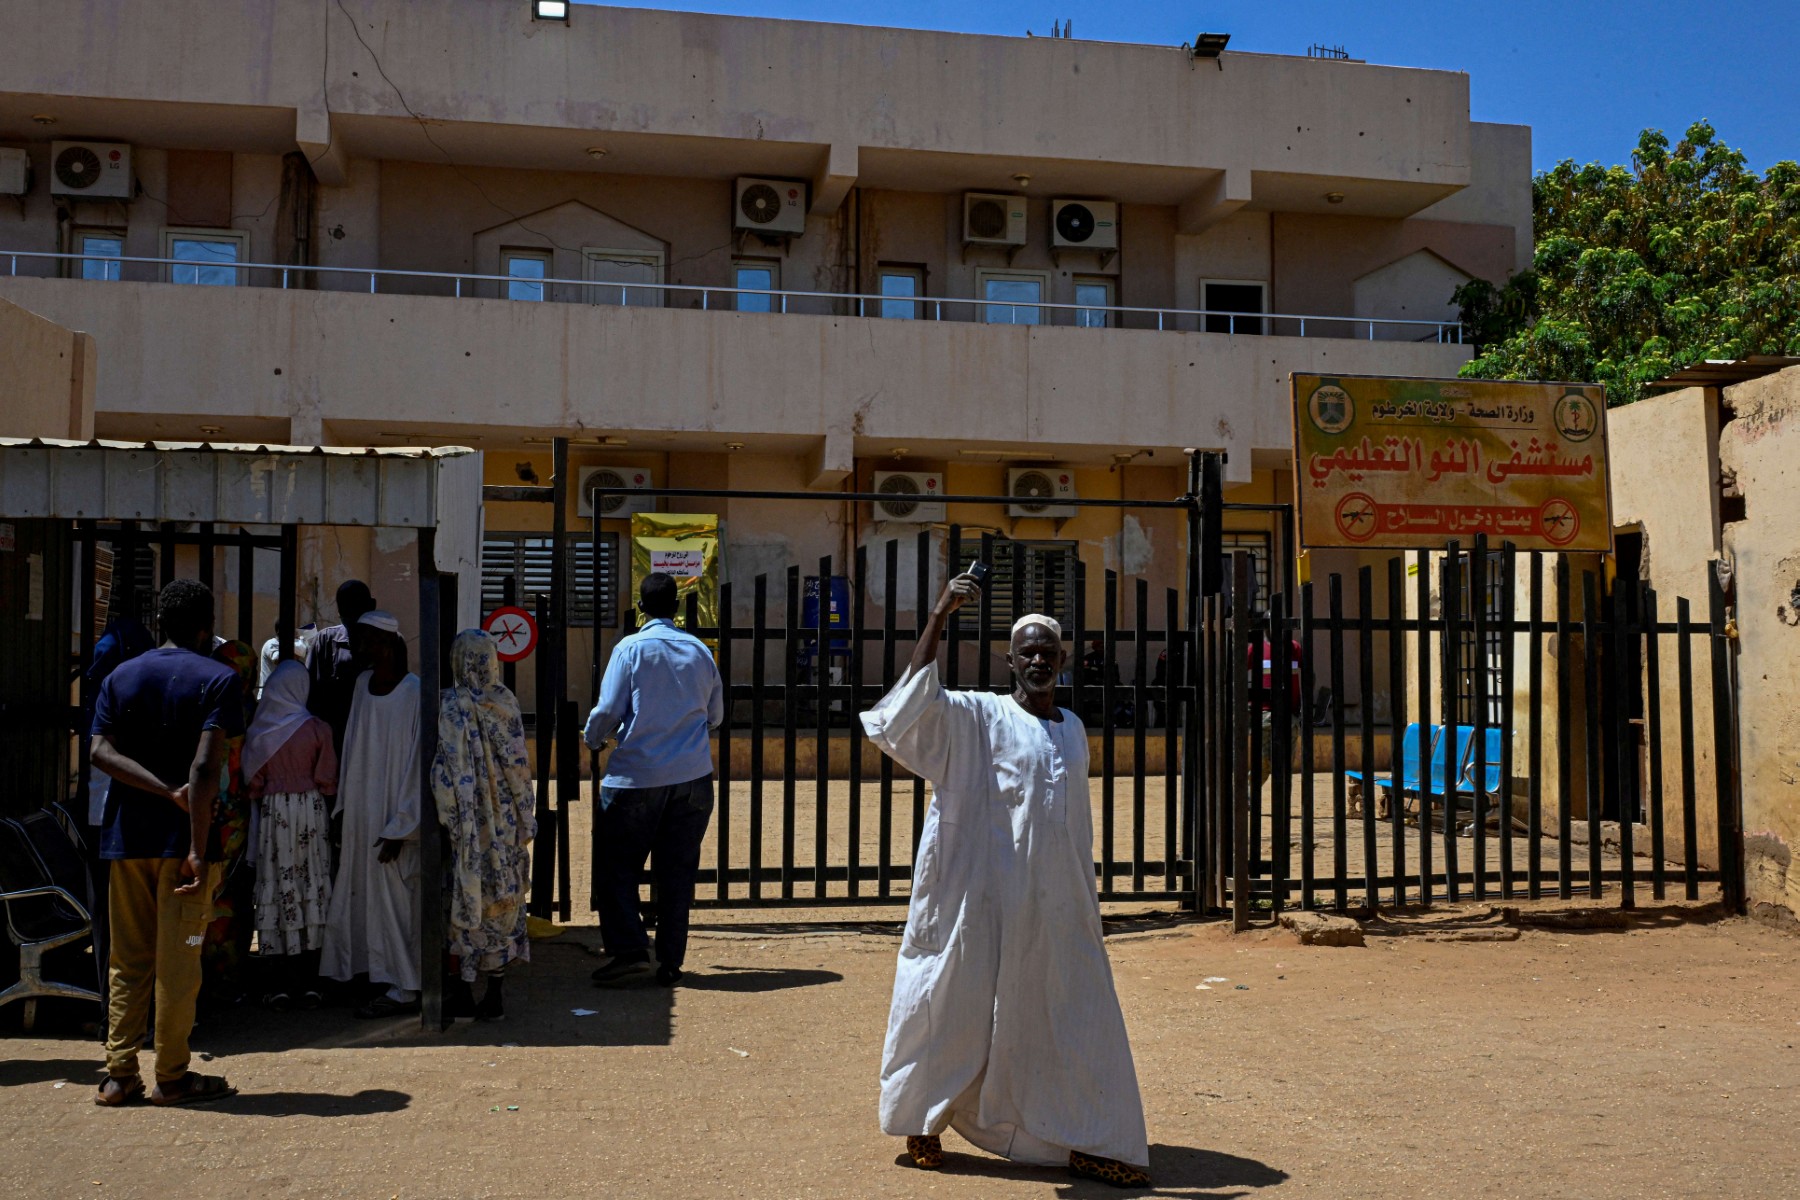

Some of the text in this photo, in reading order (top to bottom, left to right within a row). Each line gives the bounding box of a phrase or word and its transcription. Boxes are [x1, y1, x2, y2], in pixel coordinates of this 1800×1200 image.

[109, 162, 120, 170] LG
[1371, 401, 1423, 420] الخرطوم
[1424, 401, 1456, 423] ولاية
[1468, 402, 1505, 418] الصحة
[1507, 405, 1535, 423] وزارة
[1310, 437, 1594, 488] مستشفى النو التعليمي
[1386, 507, 1532, 533] يمنع دخول السلاح
